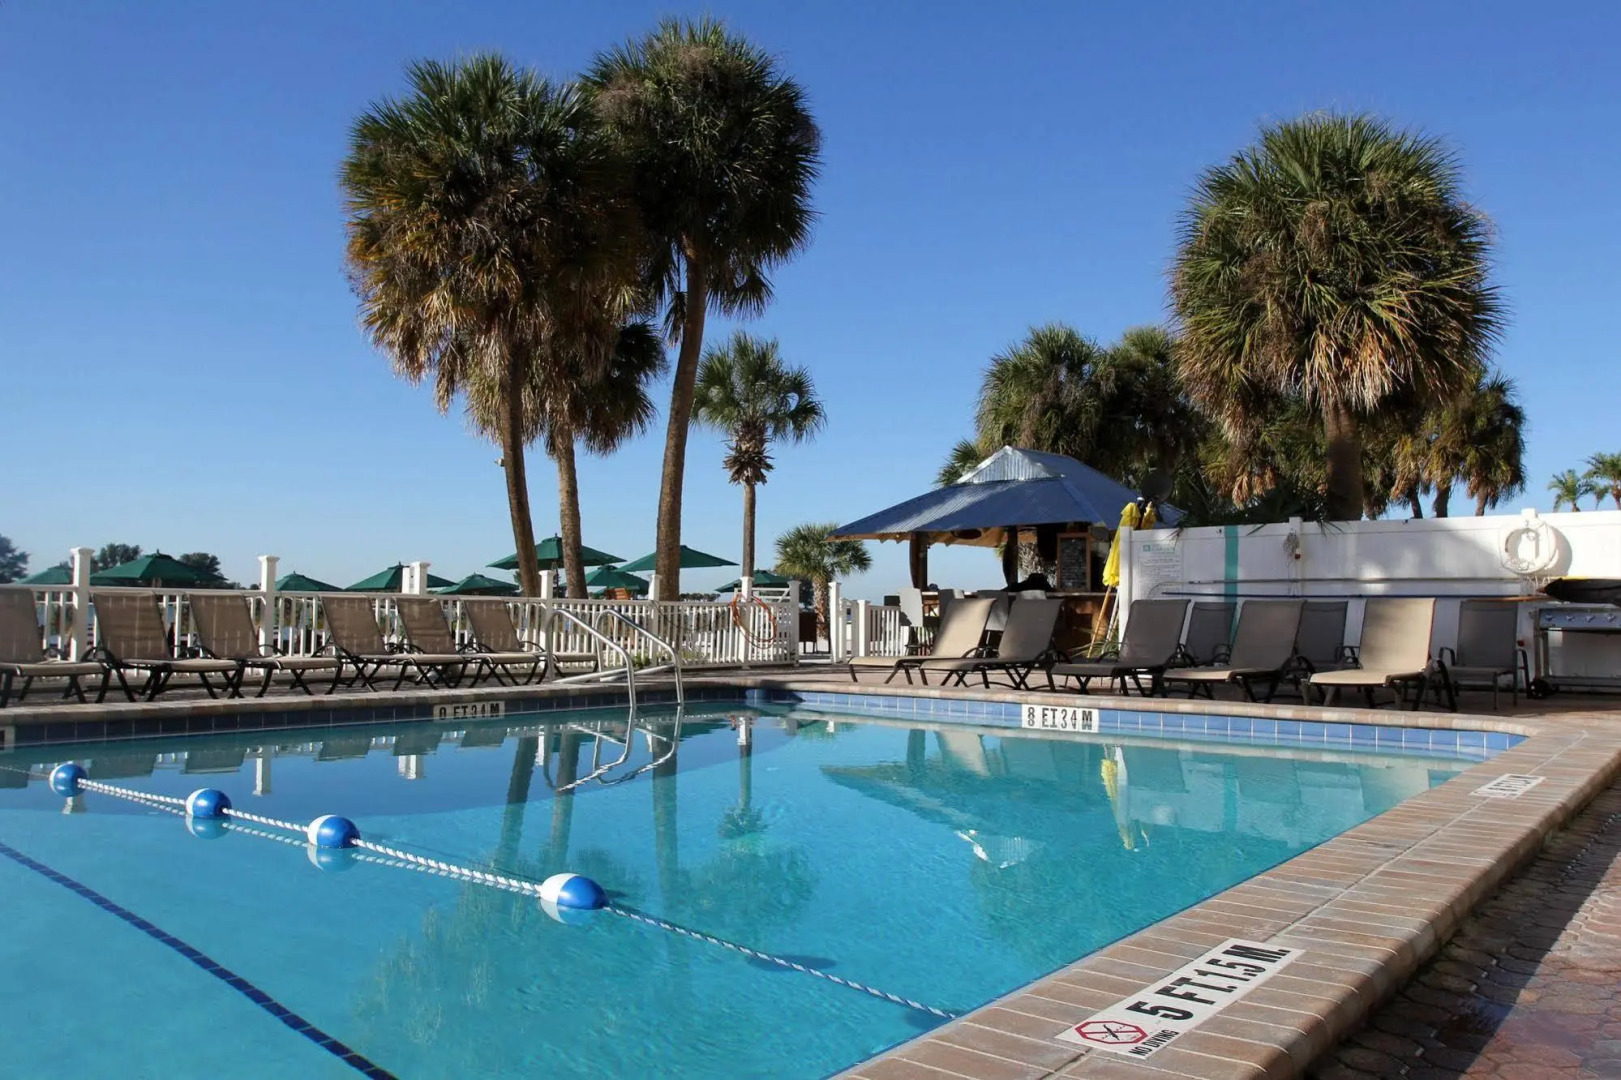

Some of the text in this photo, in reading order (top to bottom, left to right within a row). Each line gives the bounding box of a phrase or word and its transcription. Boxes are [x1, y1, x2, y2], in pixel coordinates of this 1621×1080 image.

[1125, 1000, 1194, 1021] 5
[1128, 1029, 1180, 1057] NO DIVING
